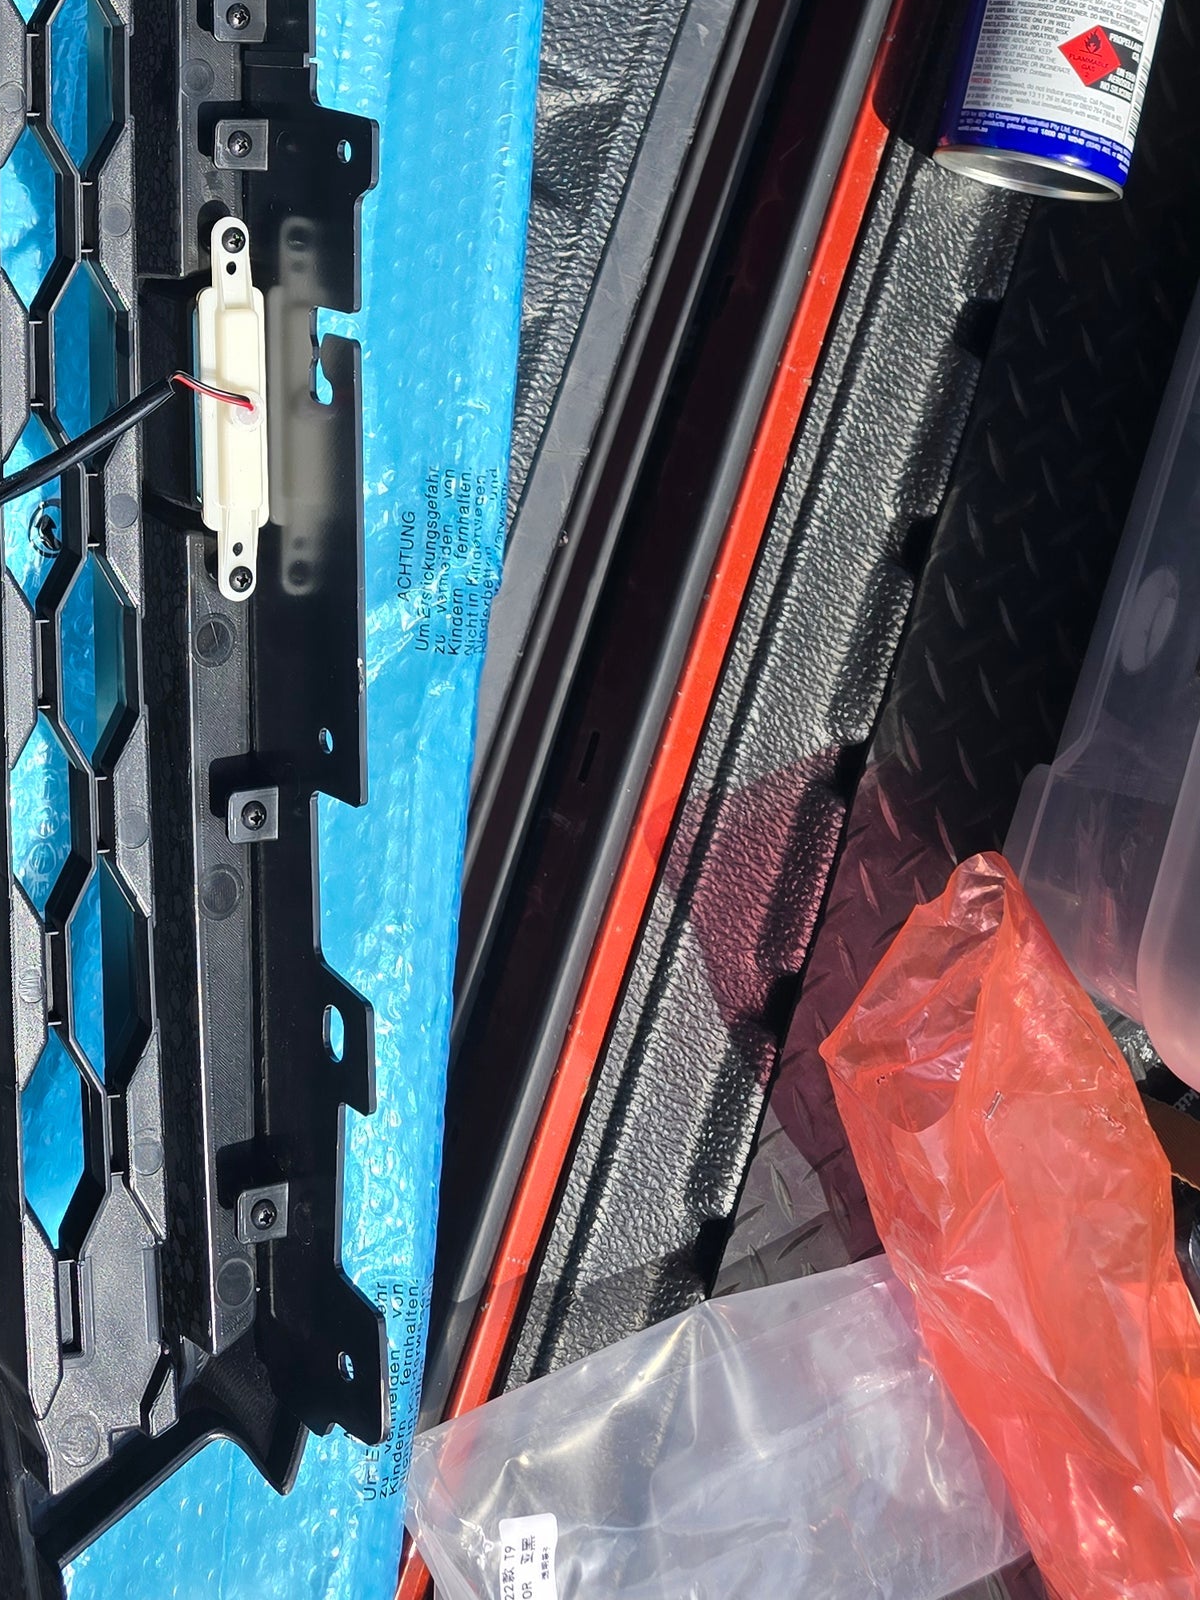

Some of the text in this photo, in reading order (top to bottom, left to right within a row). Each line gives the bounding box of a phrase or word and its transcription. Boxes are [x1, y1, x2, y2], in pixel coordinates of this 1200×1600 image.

[995, 113, 1020, 122] Company
[444, 469, 454, 498] von
[397, 511, 415, 600] ACHTUNG
[447, 468, 471, 655] Kindern fernhalten.
[466, 593, 478, 607] in
[415, 624, 430, 650] Um
[388, 1419, 406, 1494] Kindern
[400, 1278, 420, 1385] fernhalten.
[379, 1476, 389, 1498] zu
[503, 1545, 515, 1560] T9
